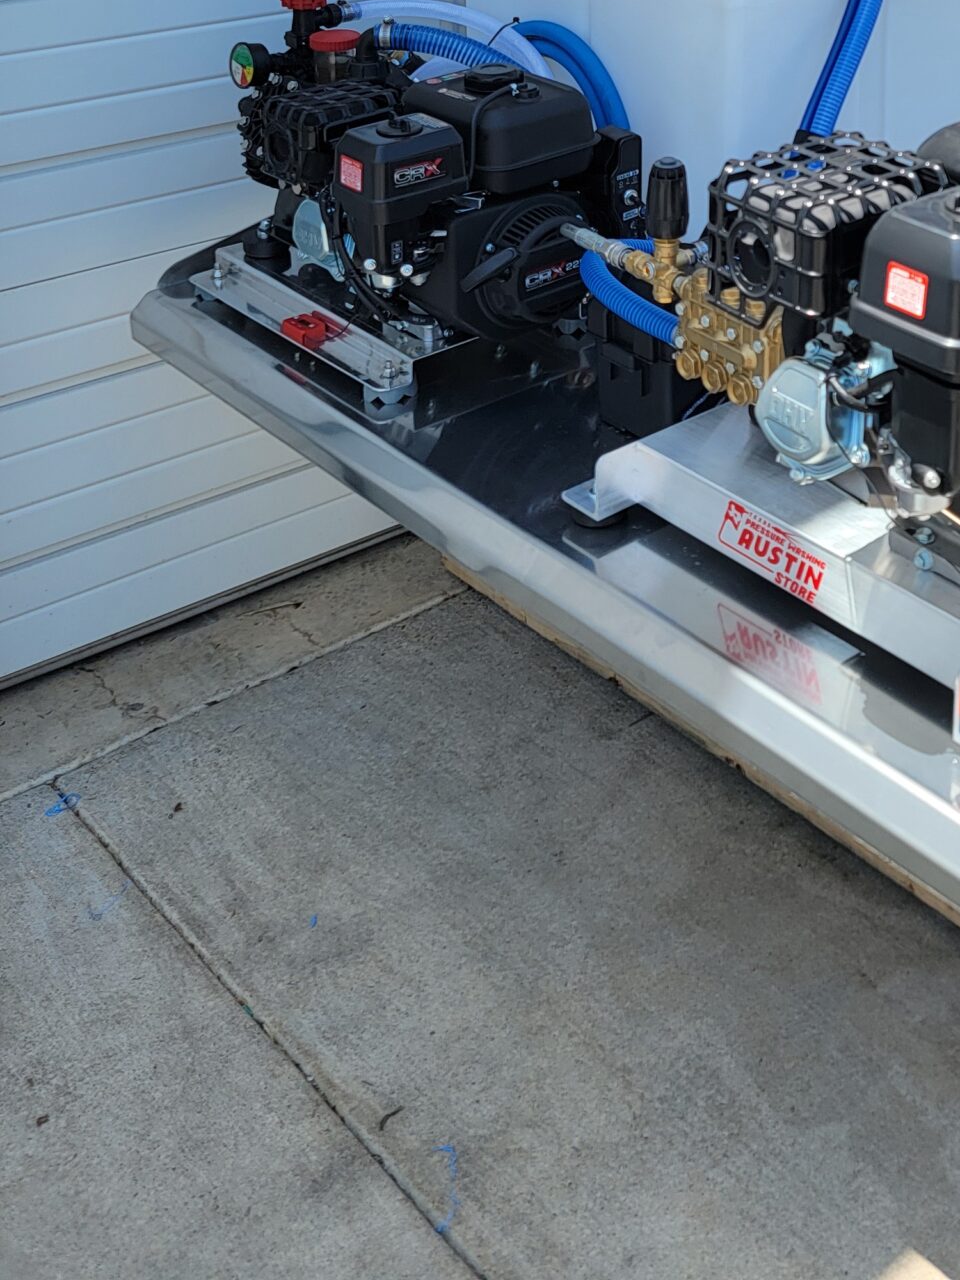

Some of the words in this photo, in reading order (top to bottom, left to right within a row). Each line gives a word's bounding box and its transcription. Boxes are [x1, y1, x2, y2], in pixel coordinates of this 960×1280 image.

[394, 158, 443, 186] CRX
[737, 528, 824, 591] AUSTIN
[745, 518, 786, 547] PRESSURE
[787, 542, 827, 570] WASHING
[774, 572, 817, 604] STORE
